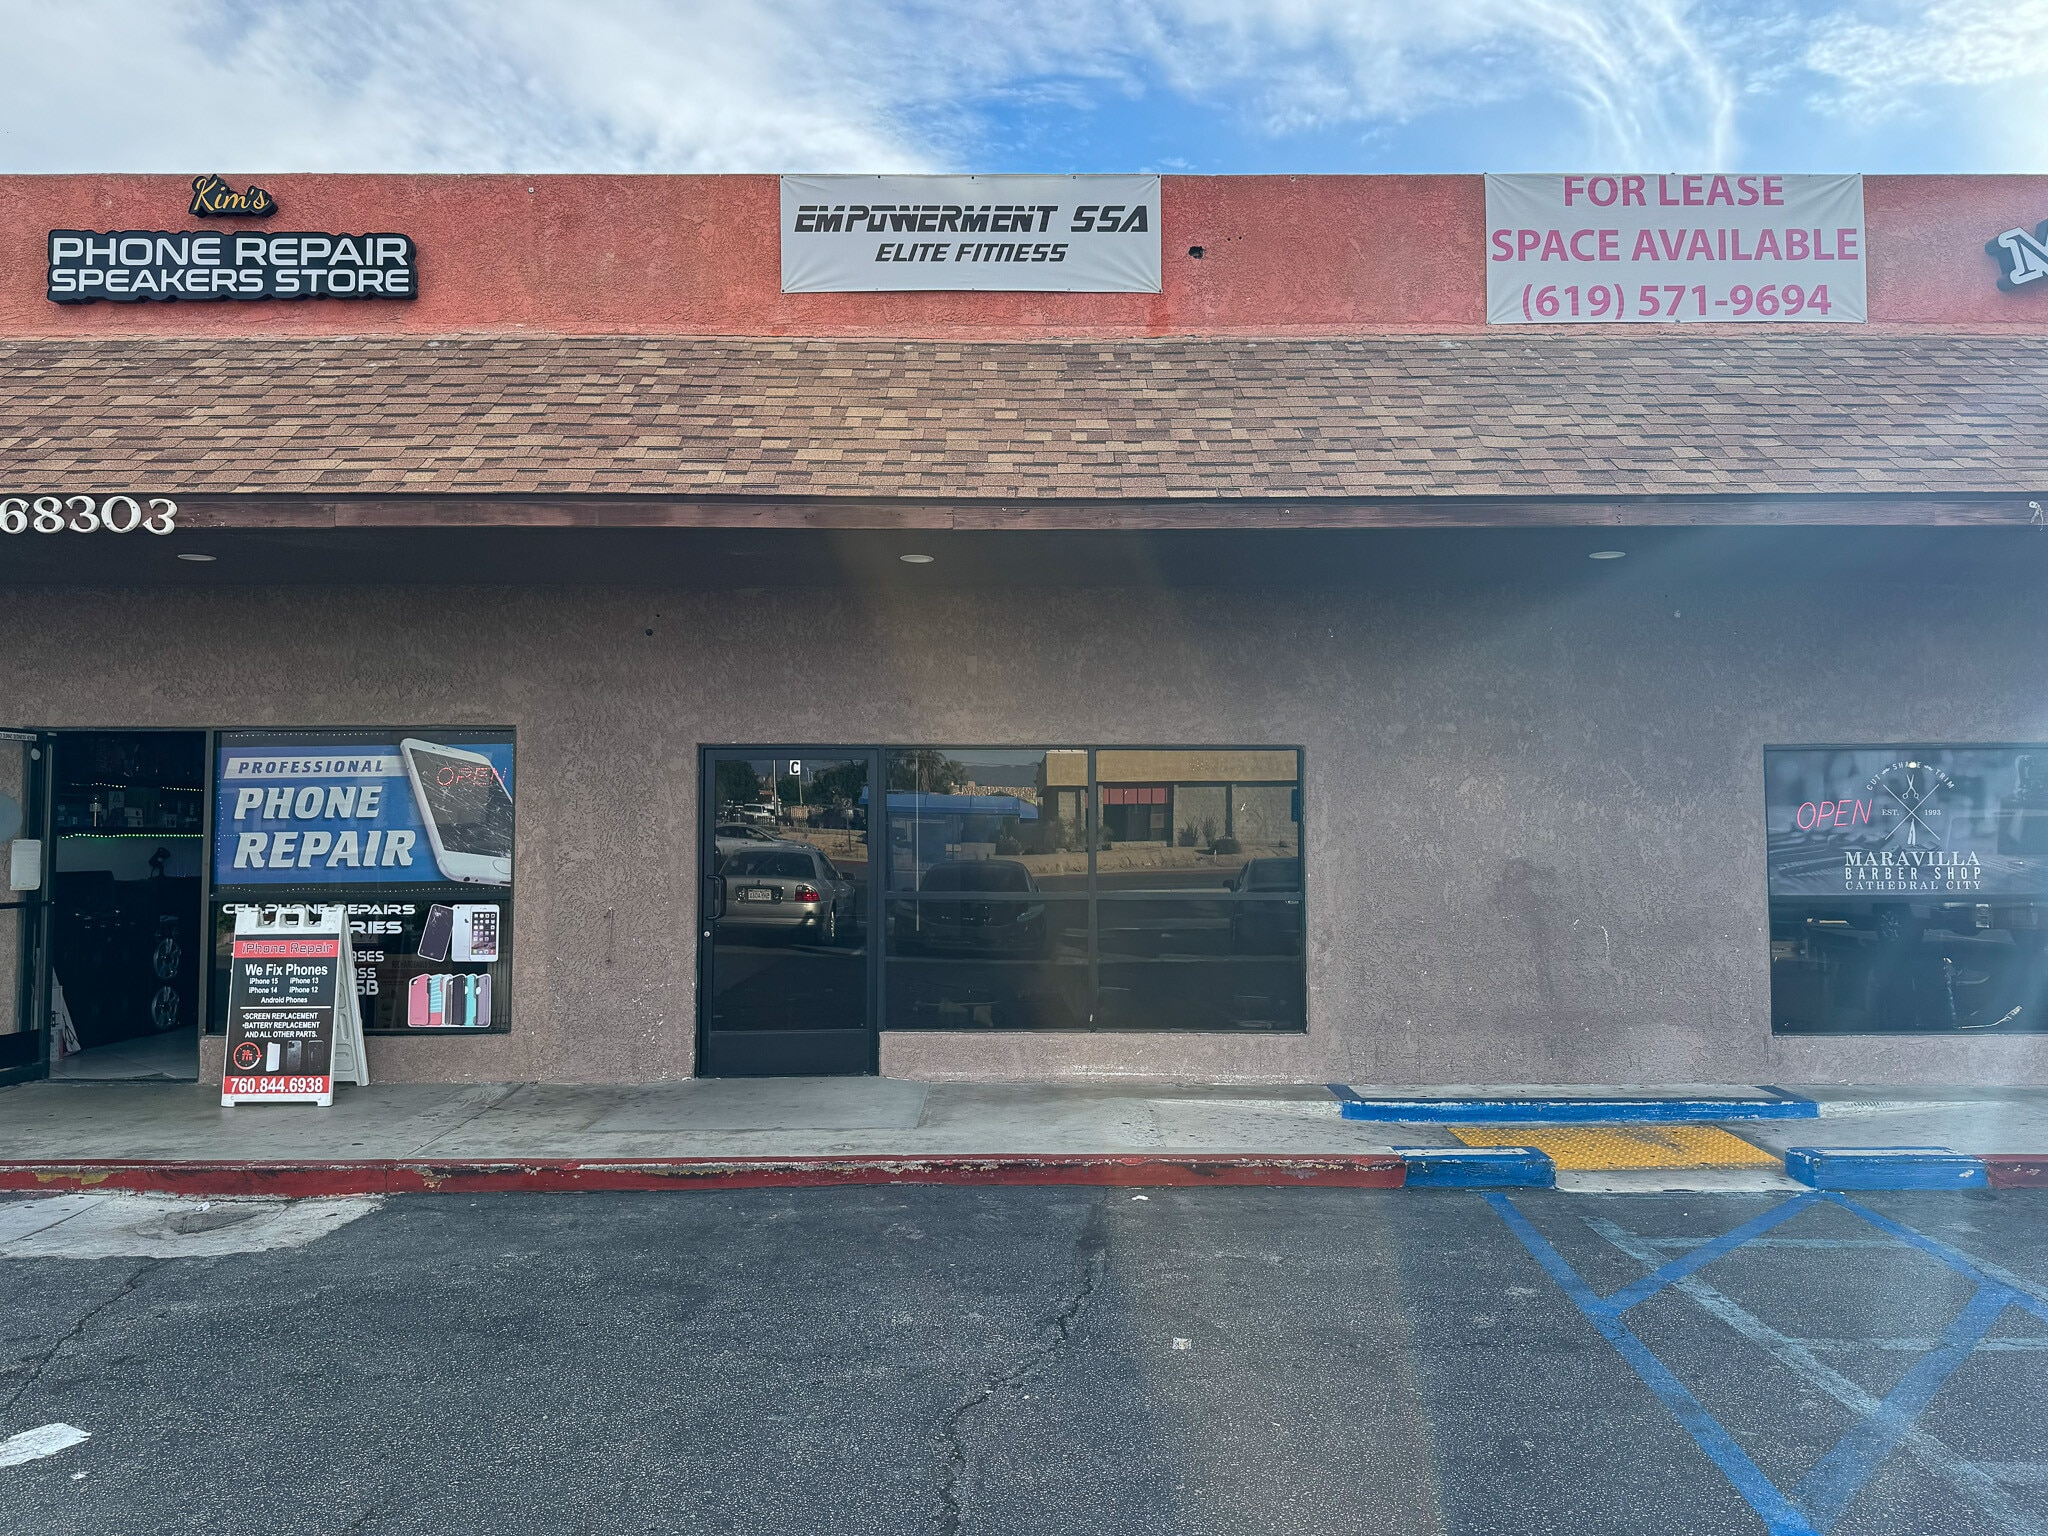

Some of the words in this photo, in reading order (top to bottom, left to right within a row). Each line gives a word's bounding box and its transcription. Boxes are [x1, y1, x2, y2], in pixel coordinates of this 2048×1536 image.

[193, 178, 270, 212] Kim's
[1563, 176, 1646, 206] FOR
[1658, 176, 1784, 206] LEASE
[794, 205, 1058, 232] EMPOWERMENT
[1070, 205, 1149, 232] SSA
[53, 238, 221, 265] PHONE
[235, 238, 408, 266] REPAIR
[875, 243, 951, 262] ELITE
[954, 243, 1069, 262] FITNESS
[1491, 229, 1620, 262] SPACE
[1631, 228, 1859, 261] AVAILABLE
[52, 269, 264, 292] SPEAKERS
[275, 269, 409, 292] STORE
[1522, 284, 1624, 321] (619)
[1638, 284, 1832, 316] 571-9694
[0, 495, 178, 535] 68303
[238, 760, 384, 774] PROFESSIONAL
[791, 761, 799, 773] C
[436, 766, 507, 786] OPEN
[1866, 774, 1881, 791] CUT
[1892, 761, 1921, 770] SHAE
[1935, 768, 1955, 789] TRIM
[233, 786, 383, 820] PHONE
[1797, 799, 1873, 830] OPEN
[233, 830, 417, 870] REPAIR
[1844, 851, 1981, 867] MARAVILLA
[1845, 867, 1918, 880] BARBER
[1934, 867, 1981, 880] SHOP
[1845, 881, 1939, 890] CATHEDRAL
[1946, 881, 1981, 890] CITY
[242, 942, 286, 953] iPhone
[290, 942, 334, 956] Repair
[245, 963, 263, 976] We
[266, 963, 283, 976] Fix
[286, 963, 329, 976] Phones
[249, 977, 270, 985] iPhone
[271, 977, 279, 985] 15
[289, 977, 310, 985] iPhone
[311, 977, 319, 985] 13
[248, 986, 270, 994] iPhone
[270, 986, 278, 994] 14
[261, 996, 284, 1004] Android
[285, 996, 308, 1004] Phones
[244, 1012, 271, 1020] SCREEN
[271, 1012, 319, 1020] REPLACEMENT
[244, 1021, 273, 1029] BATTERY
[273, 1021, 320, 1029] REPLACEMENT
[245, 1030, 259, 1038] AND
[260, 1030, 272, 1038] ALL
[272, 1030, 295, 1038] OTHER
[295, 1030, 318, 1038] PARTS.
[230, 1077, 323, 1093] 760.844.6938
